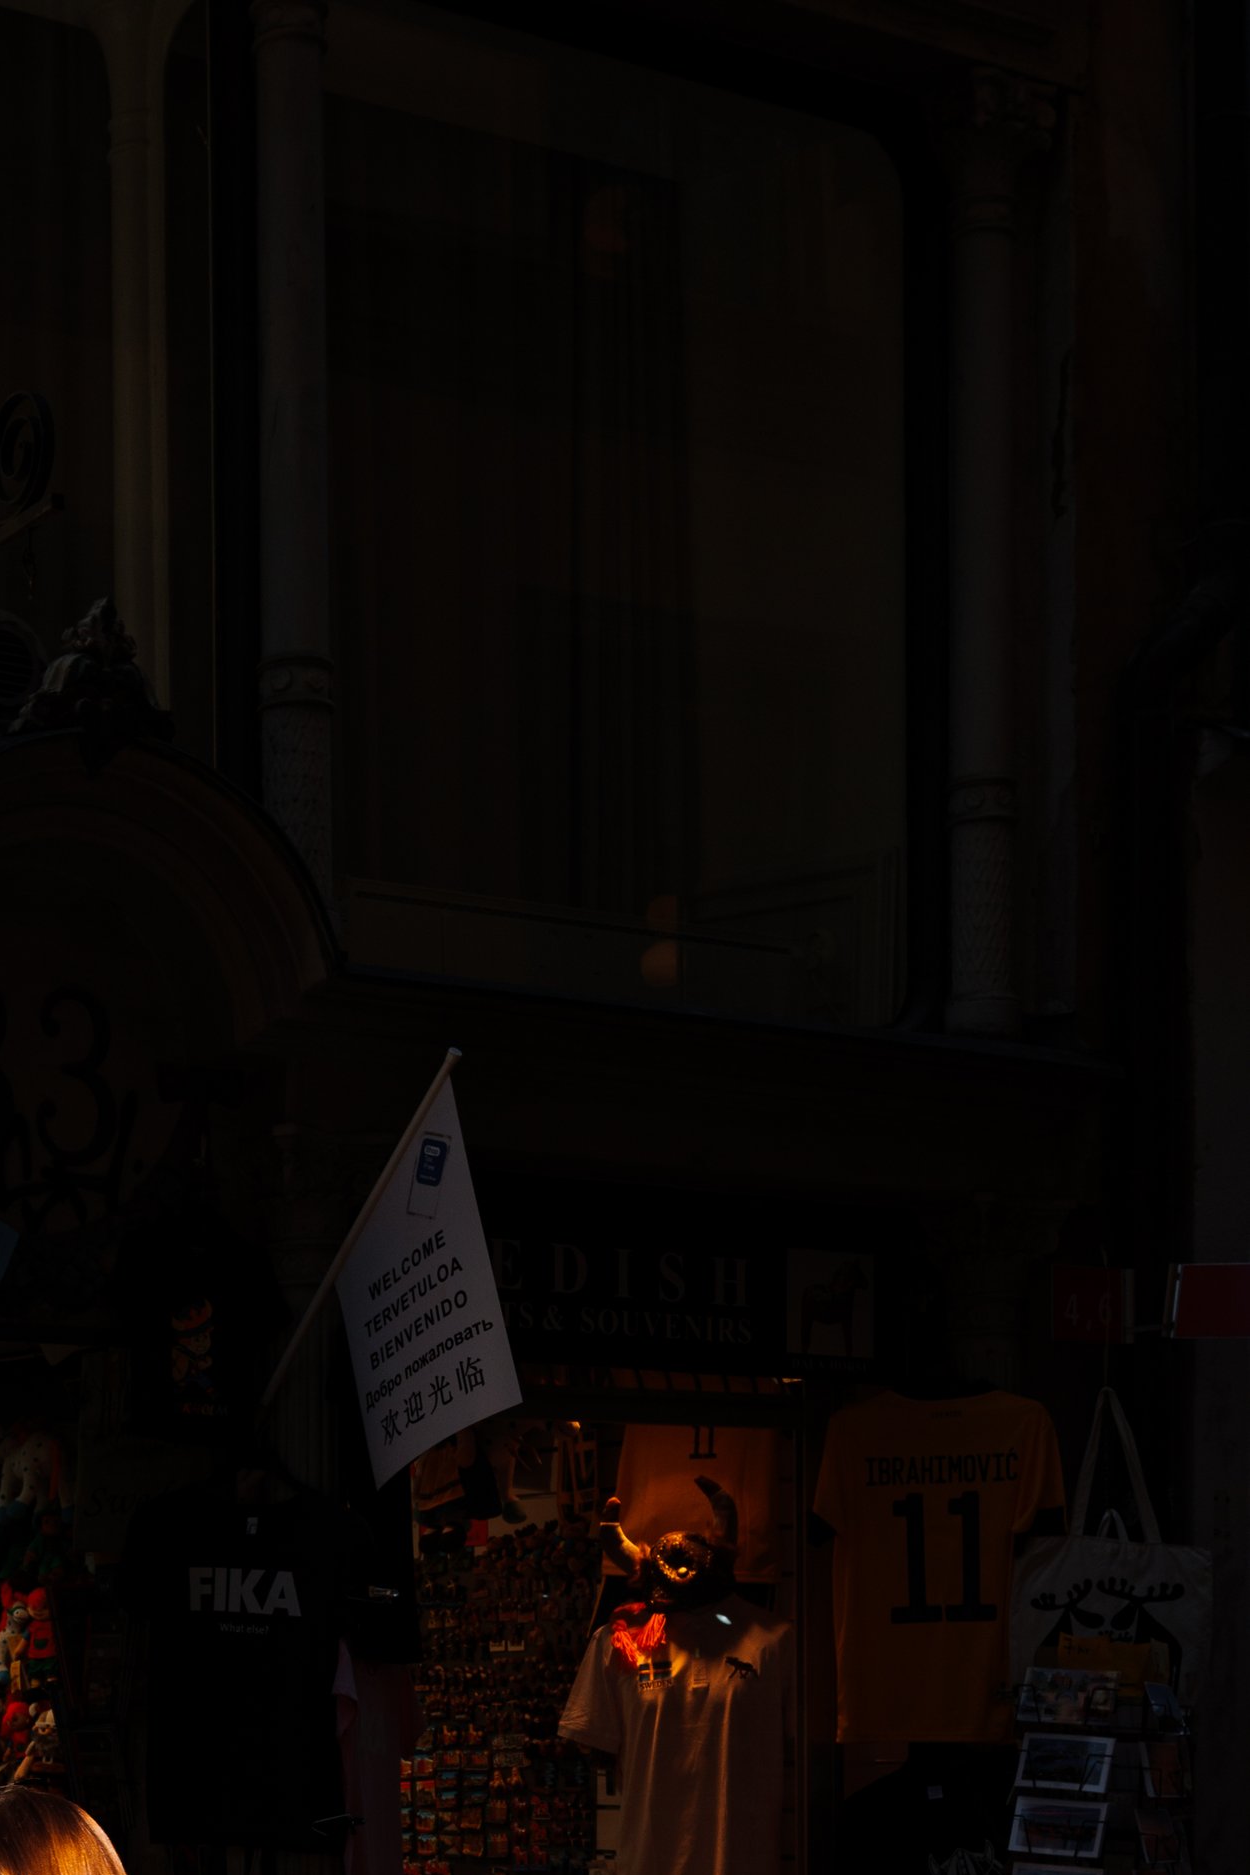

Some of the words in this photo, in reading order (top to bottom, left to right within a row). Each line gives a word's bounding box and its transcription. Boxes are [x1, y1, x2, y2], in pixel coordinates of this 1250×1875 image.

[364, 1257, 463, 1337] TERVETULOA
[368, 1230, 447, 1301] WELCOME
[491, 1238, 751, 1309] EDISH
[369, 1290, 468, 1371] BIENVENIDO
[541, 1304, 566, 1332] &
[579, 1306, 754, 1345] SOUVENIRS
[366, 1372, 403, 1413] Добро
[405, 1319, 494, 1380] пожаловать
[380, 1357, 486, 1446] 欢迎光临
[865, 1447, 1019, 1488] IBRAHIMOVIĆ
[188, 1566, 303, 1618] FIKA
[890, 1491, 997, 1624] 11
